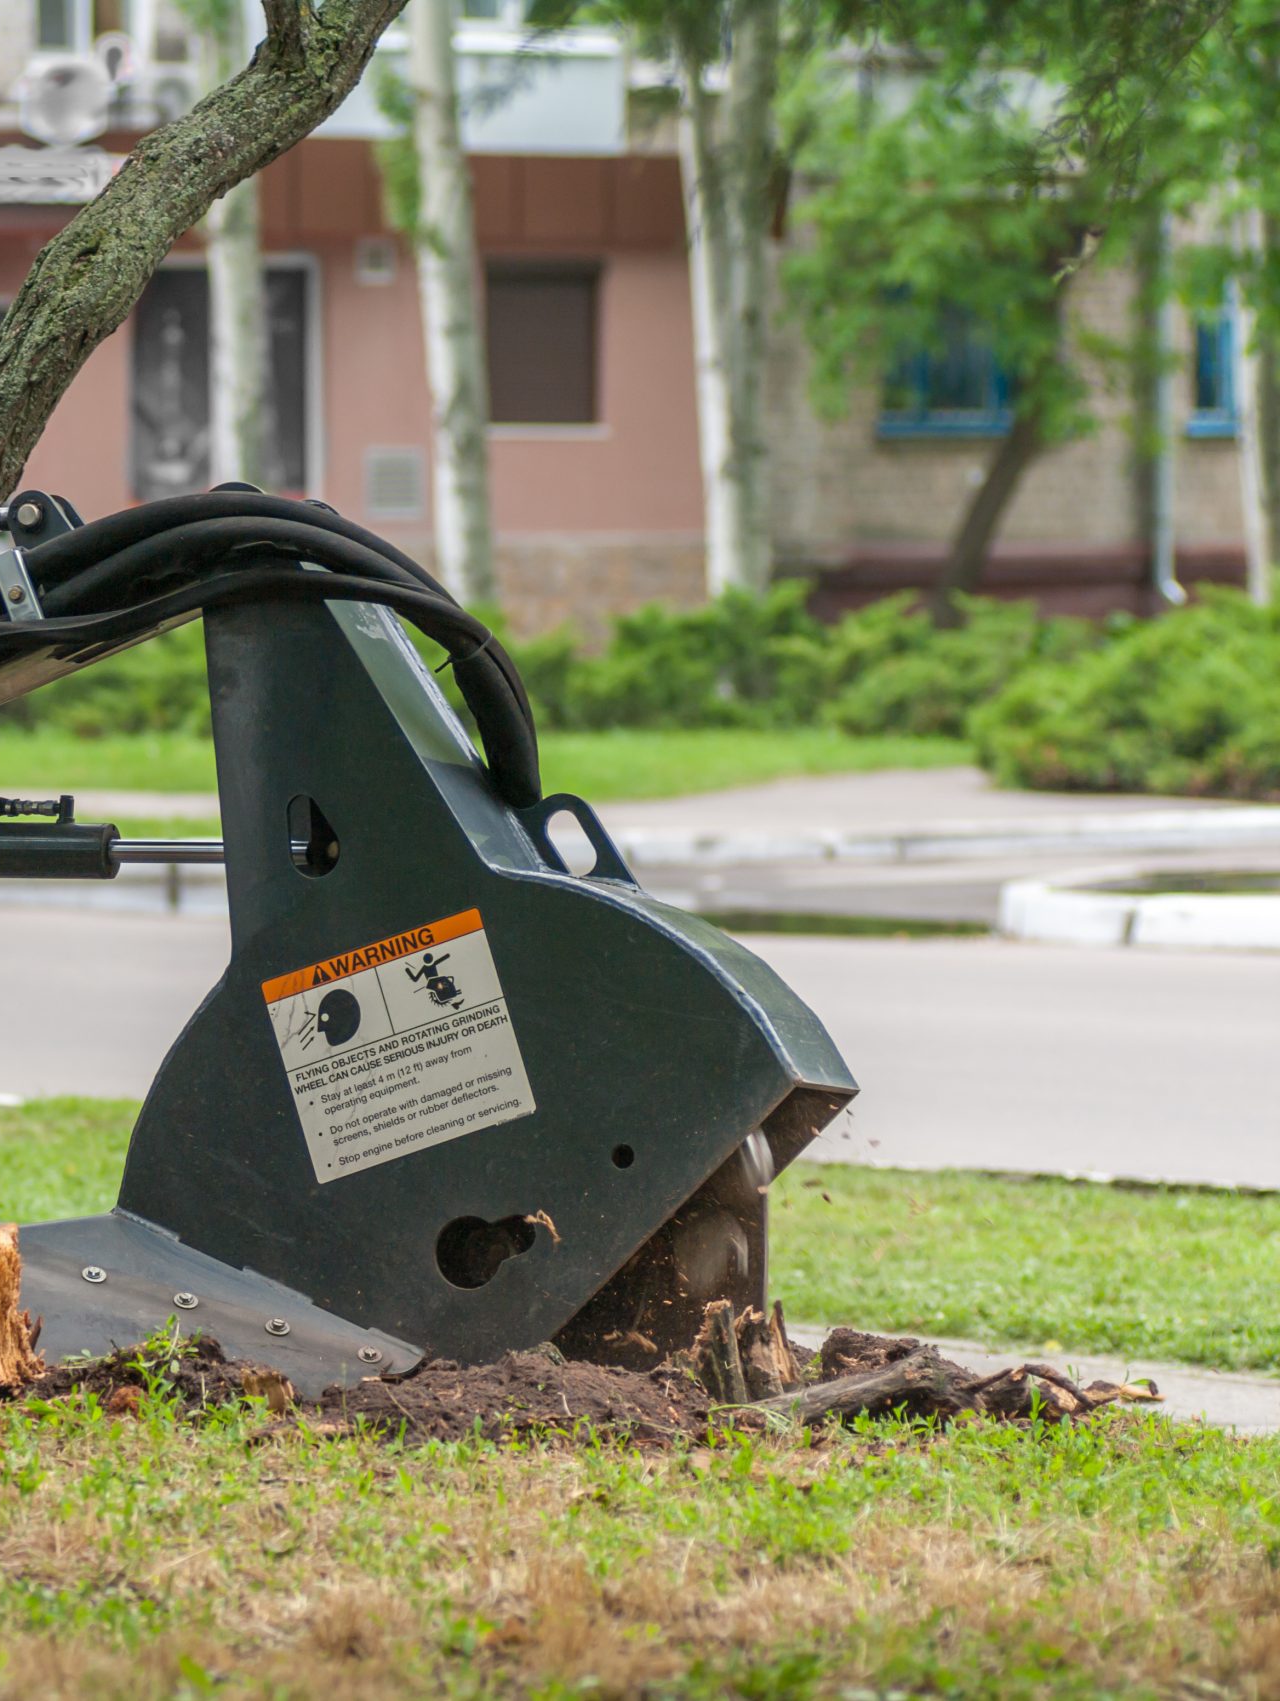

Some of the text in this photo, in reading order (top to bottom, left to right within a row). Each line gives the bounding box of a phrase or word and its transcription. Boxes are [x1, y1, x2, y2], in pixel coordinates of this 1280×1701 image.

[328, 928, 435, 977] WARNING
[294, 1014, 508, 1095] WHEEL CAN CAUSE SERIOUS INJURY OR DEATH
[295, 1004, 500, 1082] FLYING OBJECTS AND ROTATING GRINDING
[320, 1046, 472, 1104] Stay at least 4 m (12 ft) away from
[324, 1077, 420, 1115] operating equipment.
[329, 1067, 512, 1135] Do not operate with damaged or missing
[333, 1085, 499, 1146] screens, shields or rubber deflectors.
[338, 1099, 522, 1166] Stop engine before cleaning or servicing.
